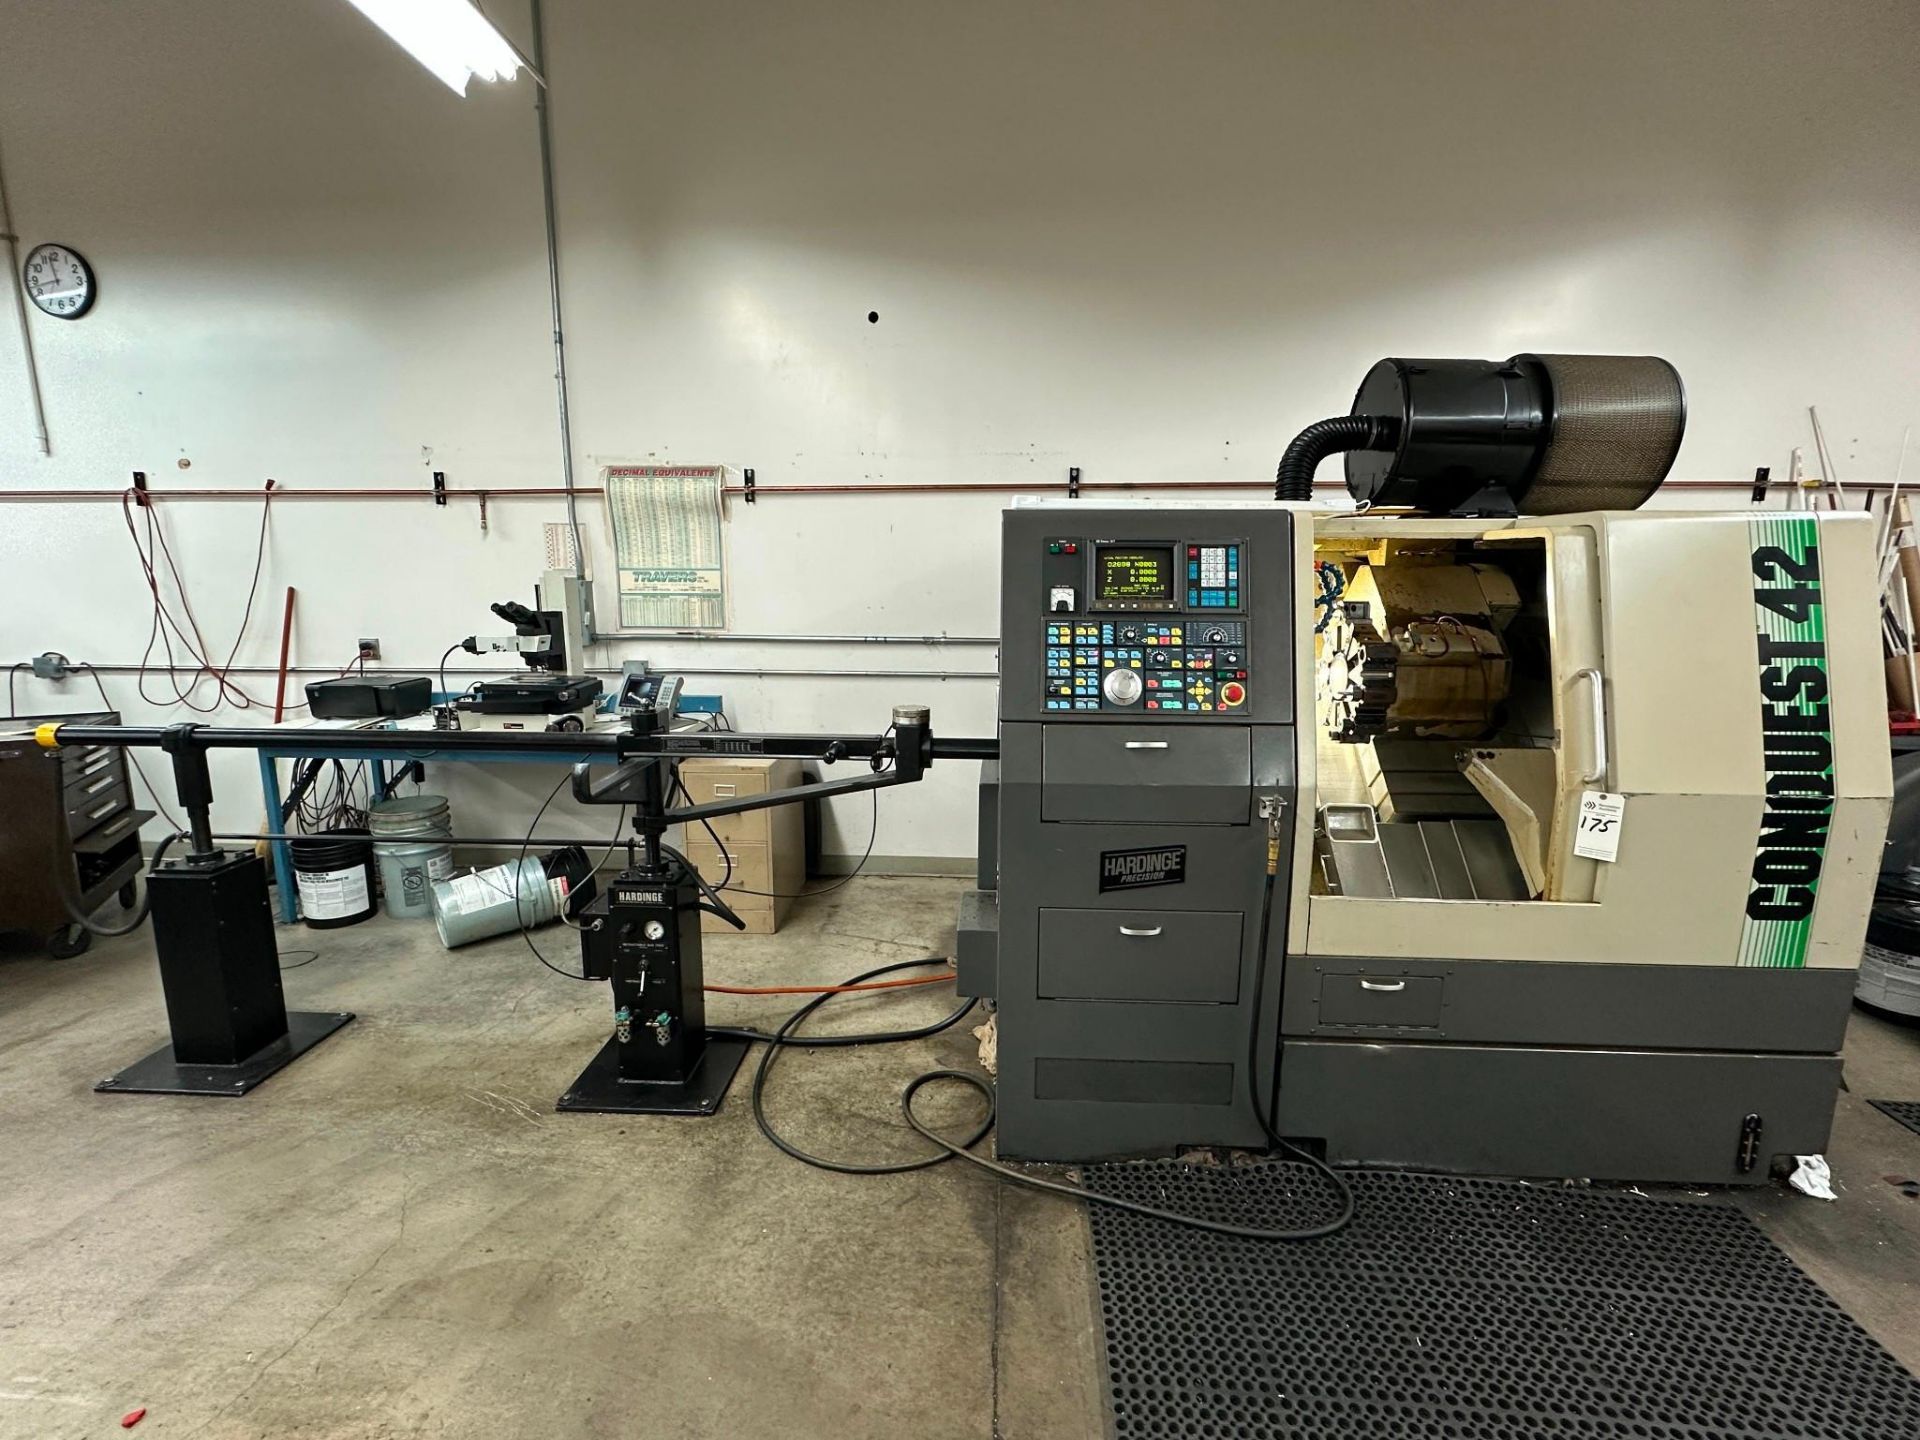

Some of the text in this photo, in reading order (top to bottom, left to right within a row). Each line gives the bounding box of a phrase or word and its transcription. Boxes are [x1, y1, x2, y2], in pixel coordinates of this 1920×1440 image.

[49, 252, 59, 262] 12
[32, 264, 42, 273] 10
[72, 264, 78, 274] 2
[32, 275, 39, 285] 9
[76, 276, 84, 286] 3
[59, 300, 65, 310] 6
[69, 297, 76, 307] 5
[653, 469, 715, 477] EQUIVALENTS
[633, 571, 697, 583] TRAVERS
[1745, 546, 1836, 921] CONQUEST 42
[1581, 816, 1618, 833] 175
[1105, 851, 1182, 877] HARDINGE
[1121, 871, 1166, 883] PRECISION
[619, 891, 663, 902] HARDINGE
